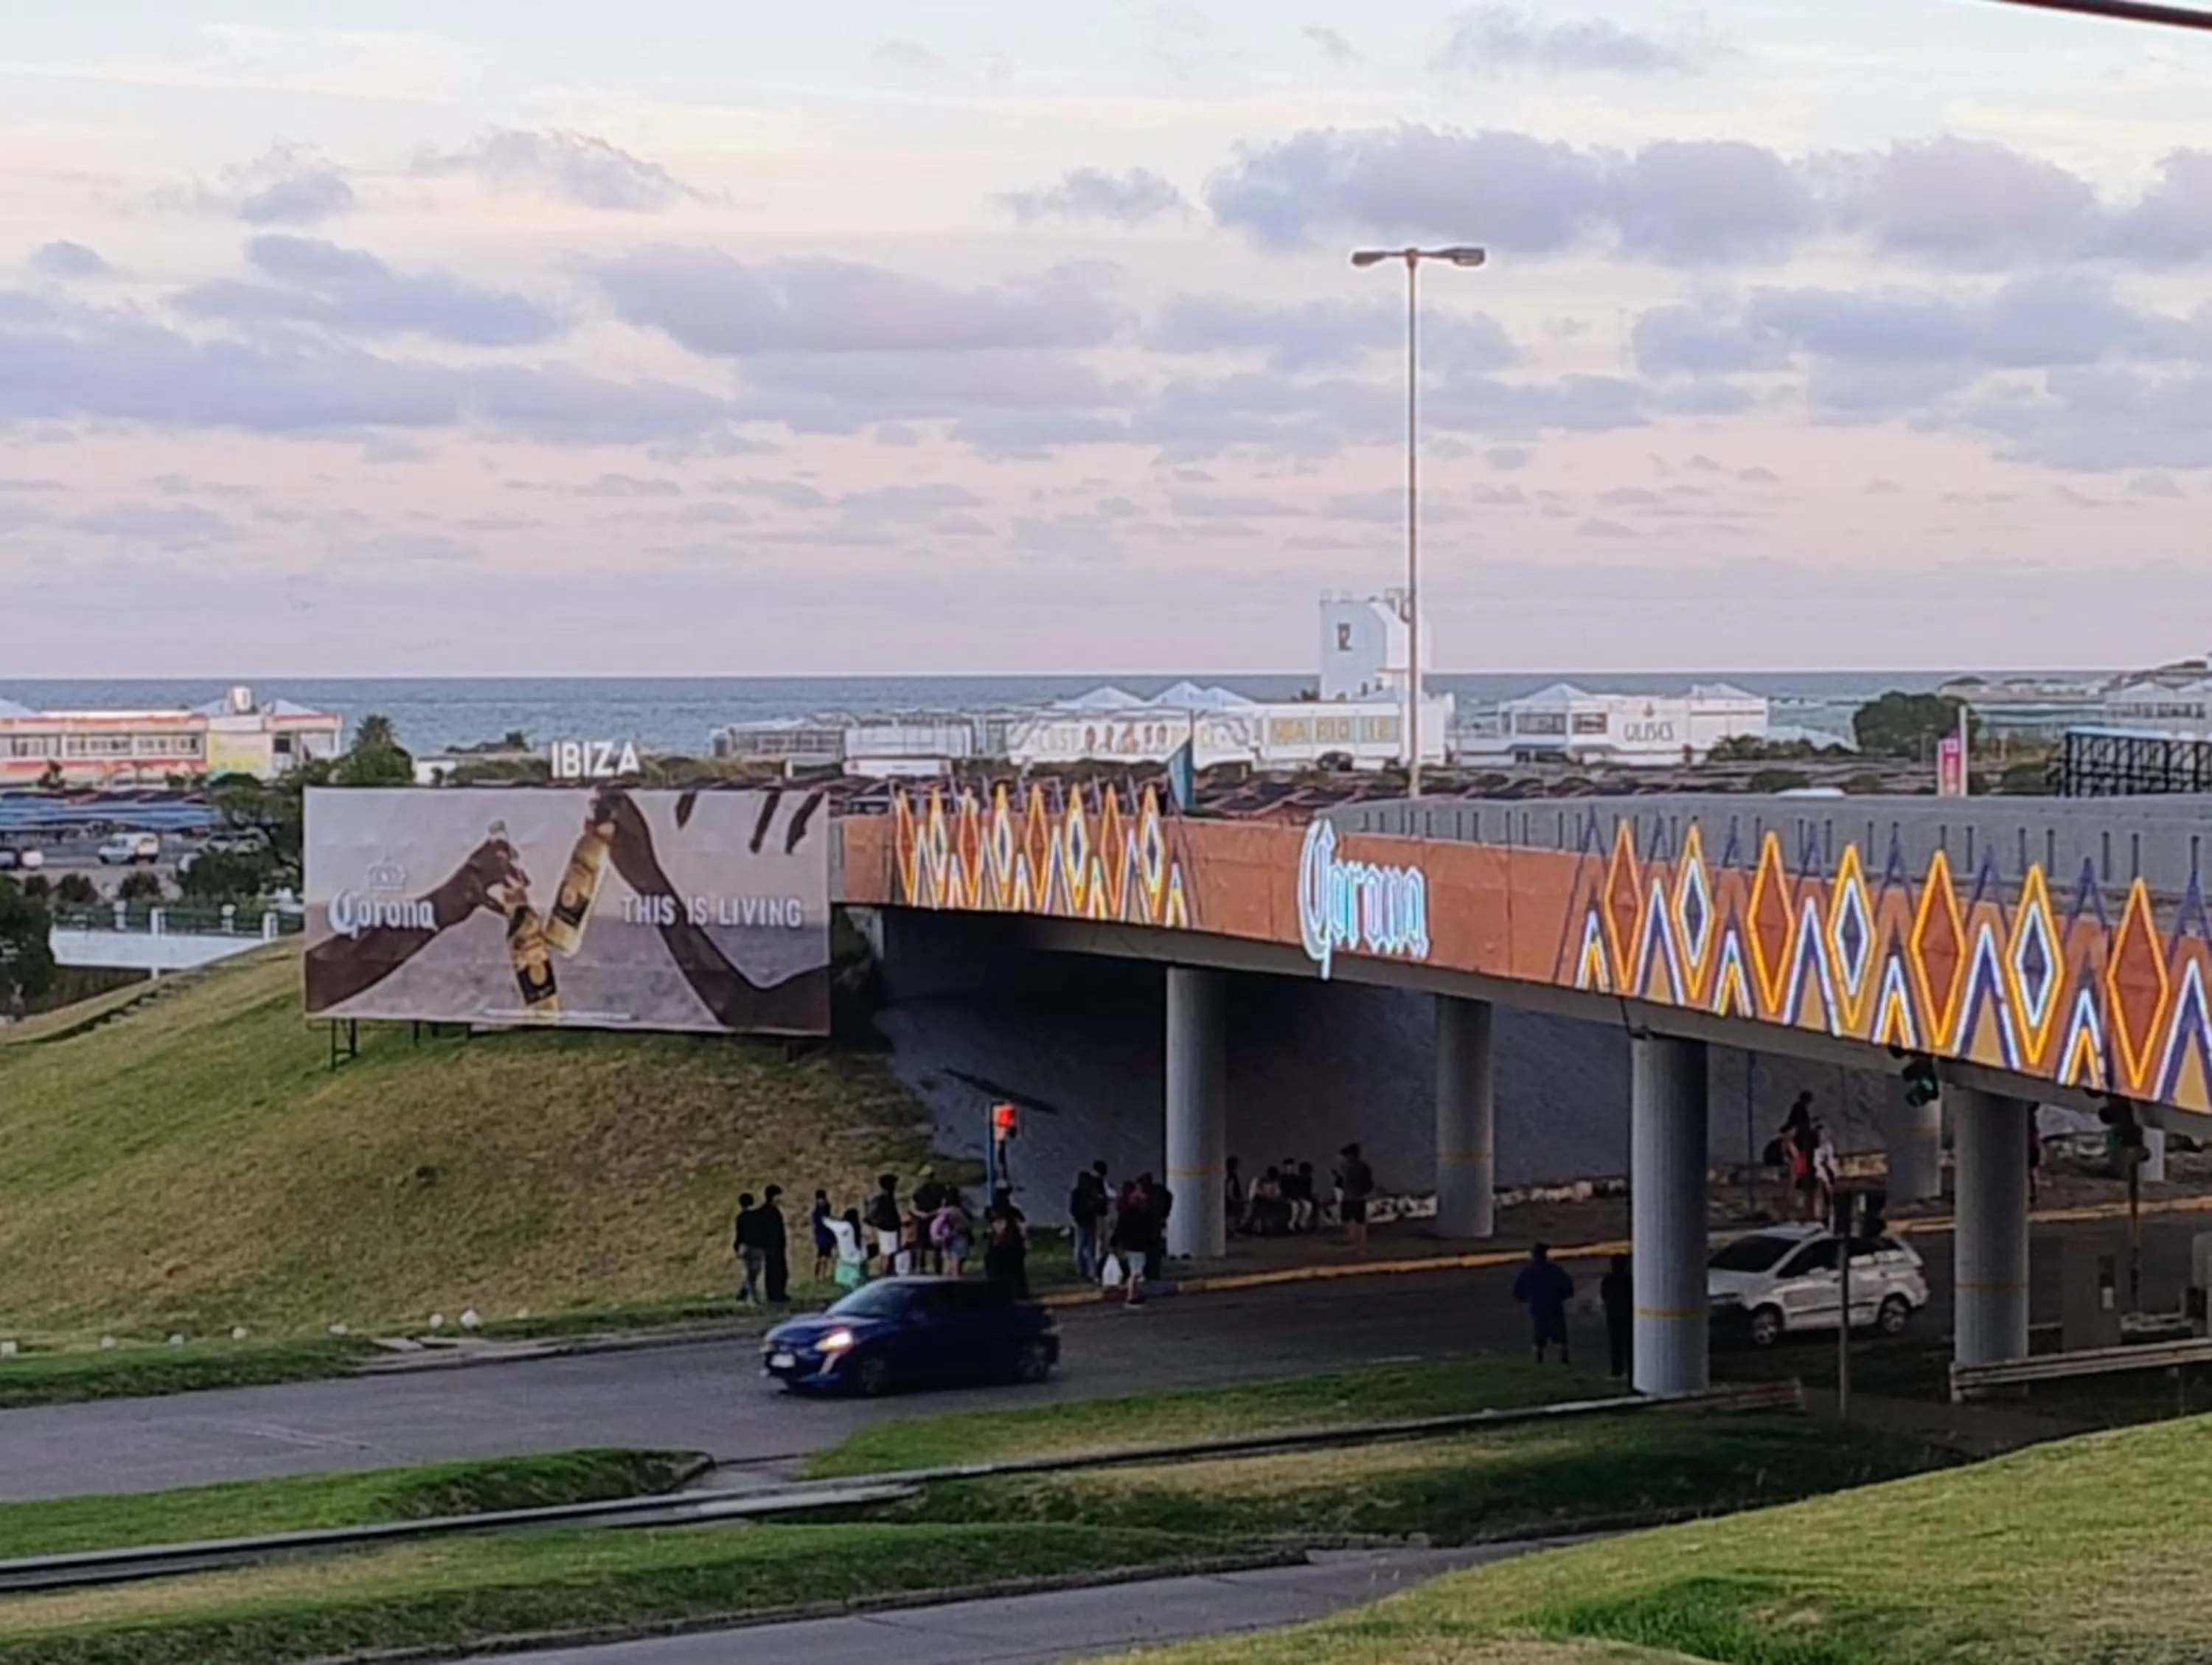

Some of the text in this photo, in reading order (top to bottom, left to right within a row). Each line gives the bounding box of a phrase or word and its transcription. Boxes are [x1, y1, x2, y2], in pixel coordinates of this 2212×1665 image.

[551, 740, 641, 779] IBIZA
[330, 887, 439, 940] Corona
[621, 894, 802, 928] THIS IS LIVING
[1298, 818, 1430, 980] Corona
